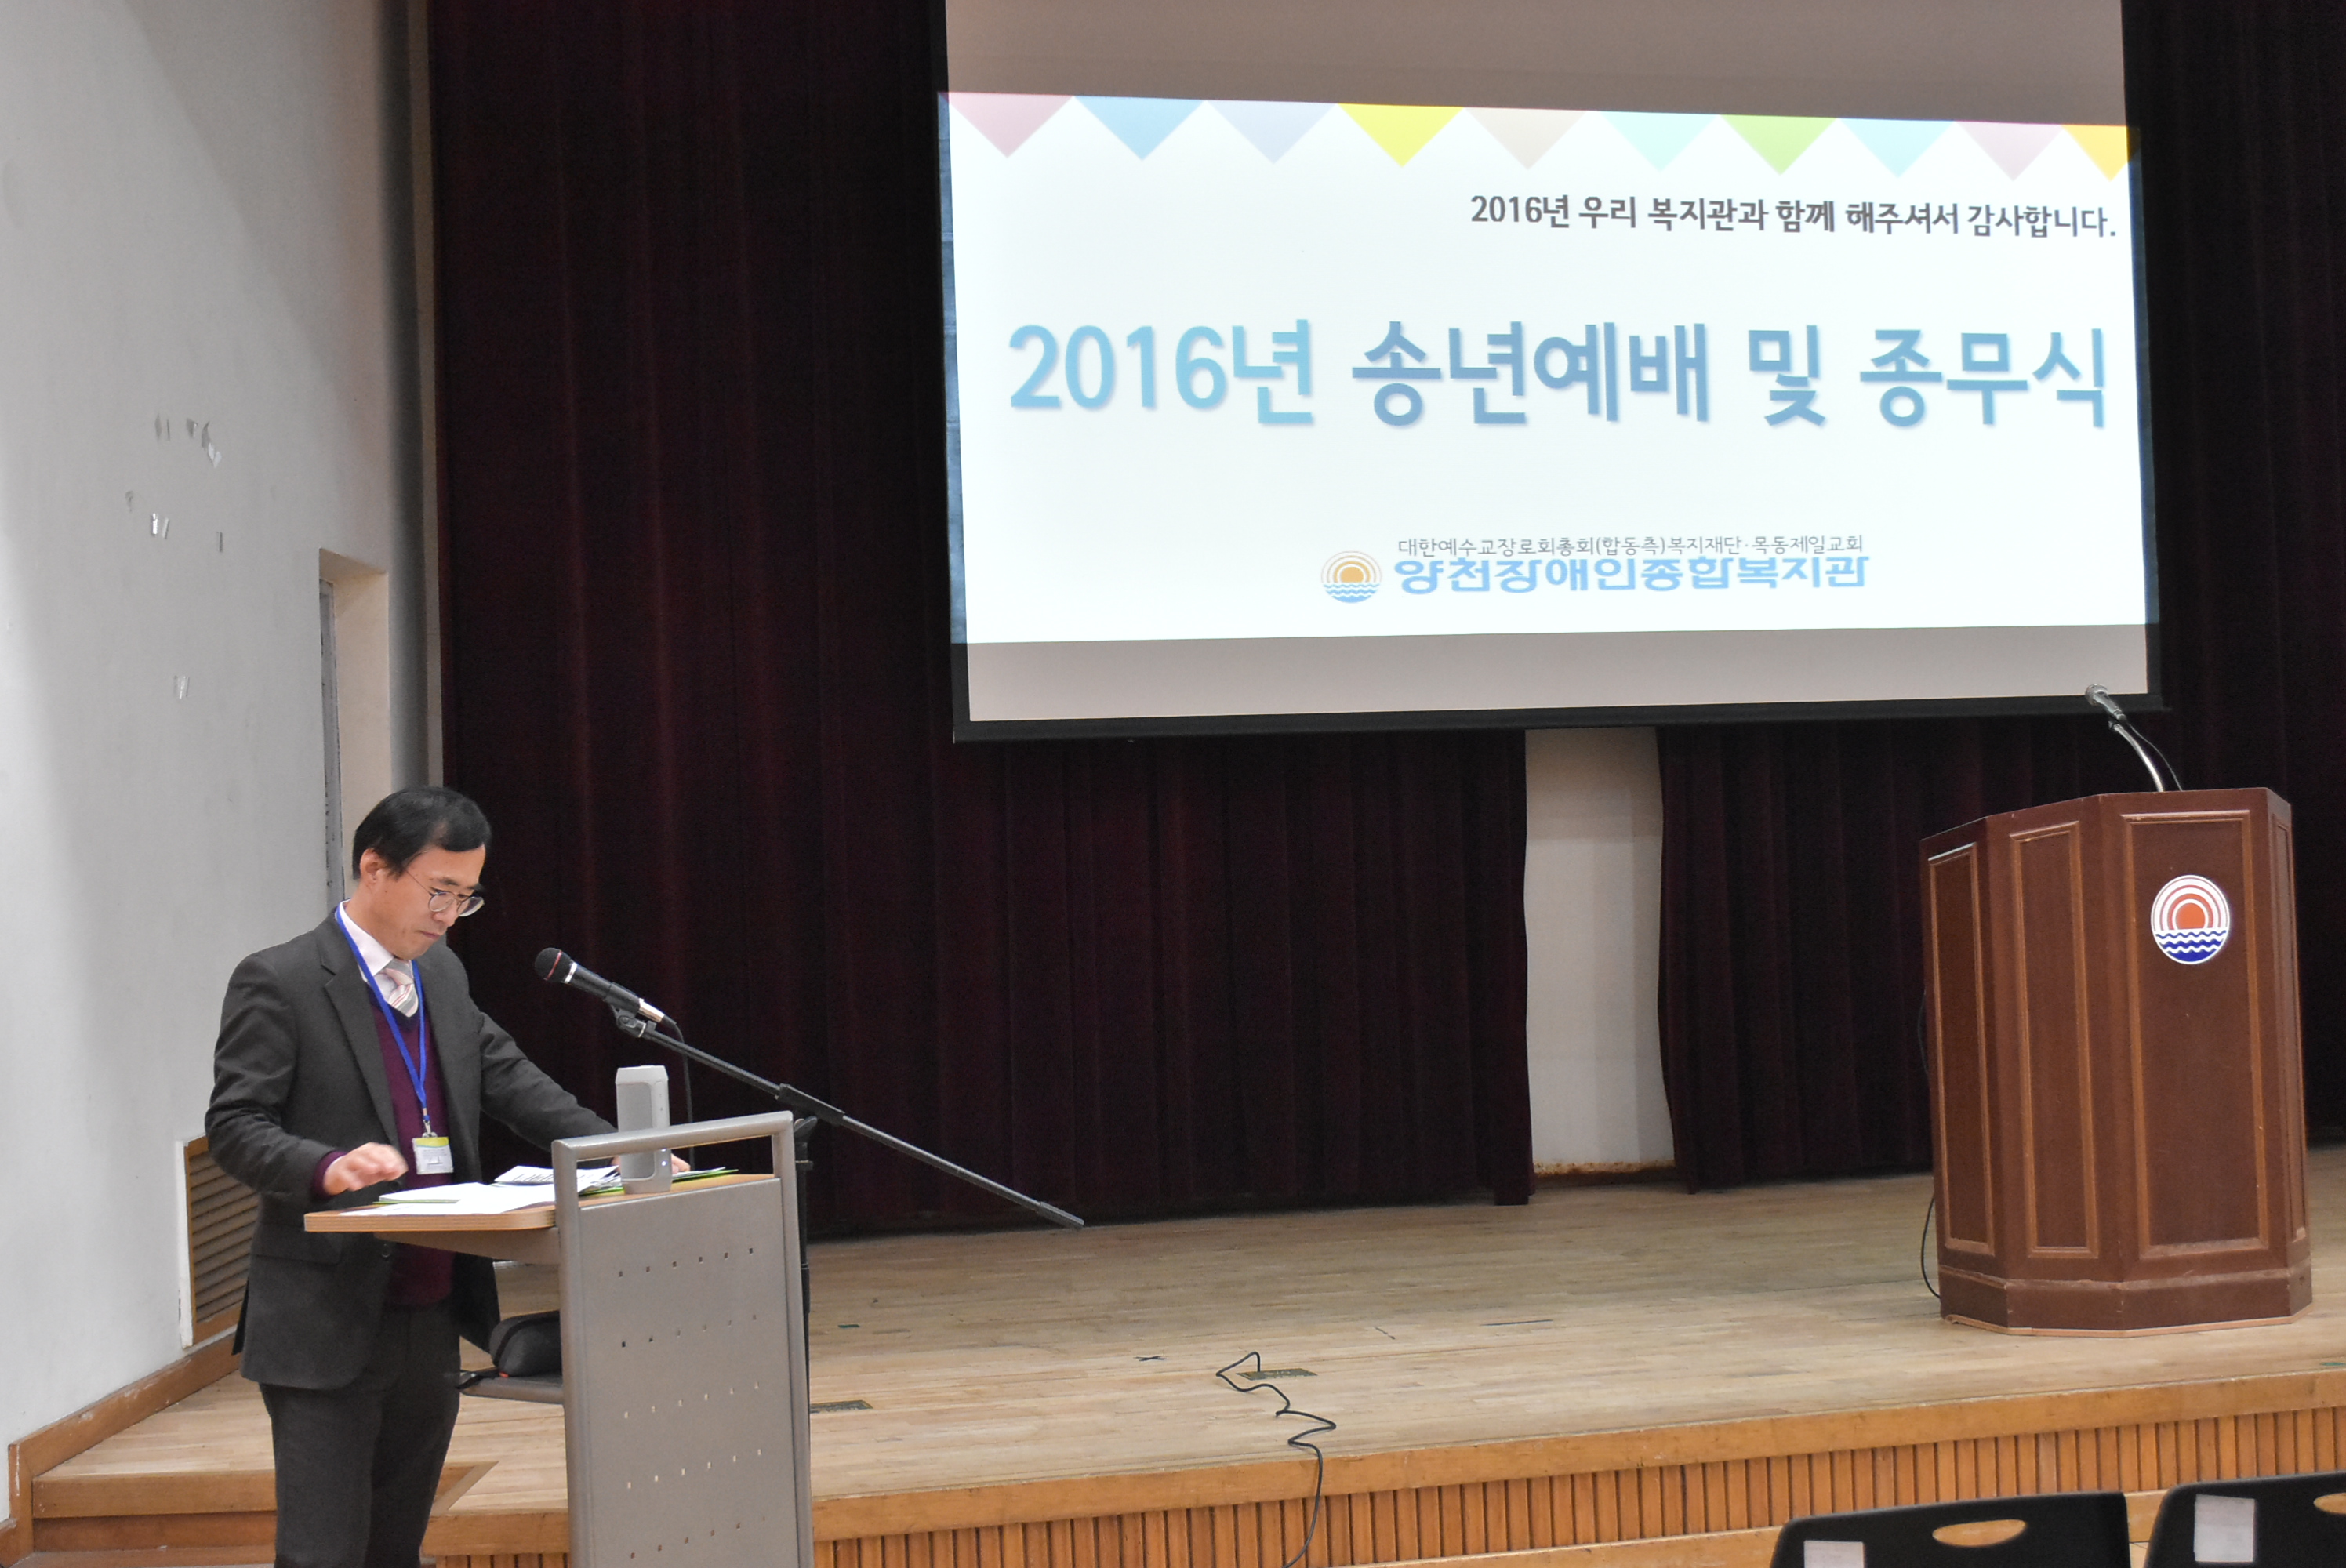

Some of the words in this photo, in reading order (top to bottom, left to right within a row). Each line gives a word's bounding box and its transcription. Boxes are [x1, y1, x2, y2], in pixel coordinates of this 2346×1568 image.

[1470, 194, 1570, 229] 2016년
[1578, 195, 1636, 229] 우리
[1647, 198, 1770, 232] 복지관과
[1775, 199, 1835, 233] 함께
[1845, 201, 1959, 235] 해주셔서
[1967, 204, 2116, 238] 감사합니다.
[1008, 318, 1315, 426] 2016년
[1351, 321, 1710, 428] 송년예배
[1748, 324, 1827, 426] 및
[1859, 328, 2106, 428] 종무식
[1393, 556, 1870, 595] 양천장애인종합복지관
